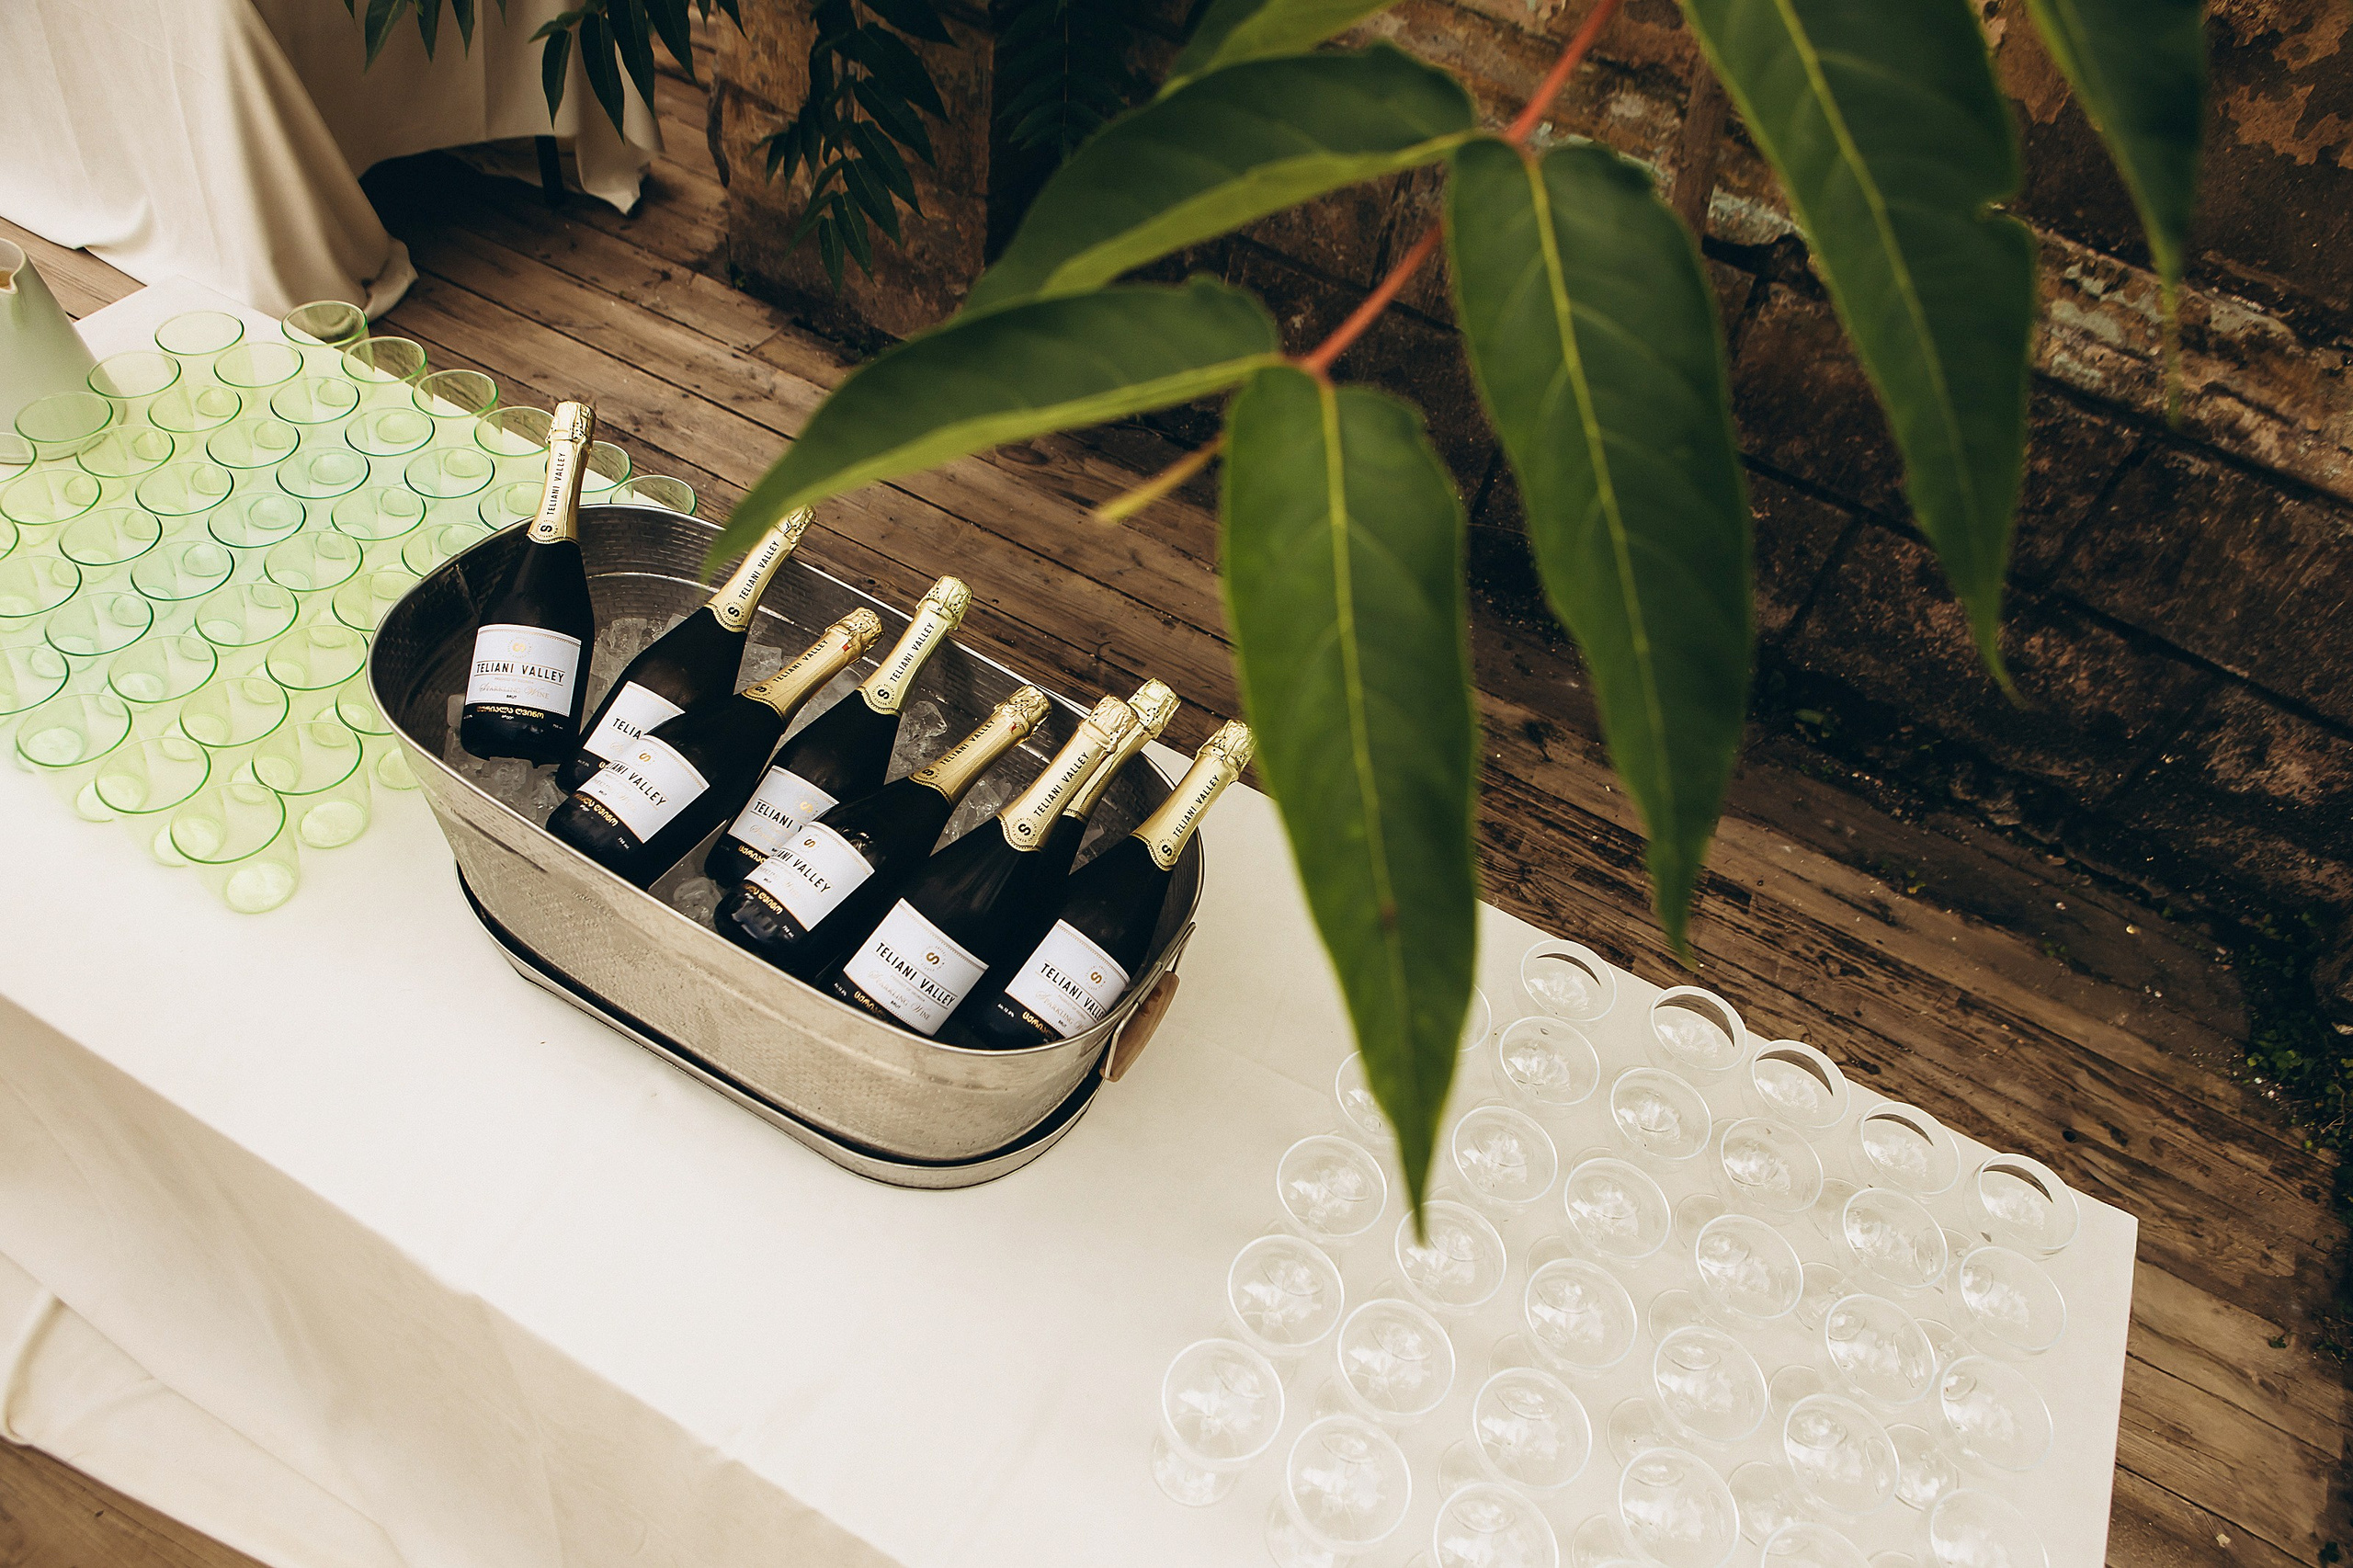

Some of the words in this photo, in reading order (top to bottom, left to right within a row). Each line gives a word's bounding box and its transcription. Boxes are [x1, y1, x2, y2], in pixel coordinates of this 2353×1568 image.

[547, 486, 560, 516] TELIANI
[554, 452, 565, 482] VALLEY
[738, 570, 761, 600] TELIANI
[757, 540, 779, 569] VALLEY
[476, 662, 514, 674] TELIANI
[521, 665, 564, 683] VALLEY
[772, 662, 802, 683] TELIANI
[801, 639, 828, 662] VALLEY
[890, 654, 915, 683] TELIANI
[911, 622, 935, 652] VALLEY
[612, 717, 642, 741] TELIA
[939, 744, 970, 766] TELIANI
[971, 720, 995, 742] VALLEY
[628, 772, 666, 806] VALLEY
[1033, 784, 1063, 818] TELIANI
[1061, 751, 1090, 783] VALLEY
[1172, 805, 1197, 838] TELIANI
[1195, 774, 1220, 806] VALLEY
[754, 801, 793, 829] TELIANI
[792, 858, 831, 892] VALLEY
[875, 942, 917, 981] TELIANI
[920, 978, 956, 1007] VALLEY
[1040, 962, 1083, 1001] TELIANI
[1084, 997, 1106, 1021] VALLE
